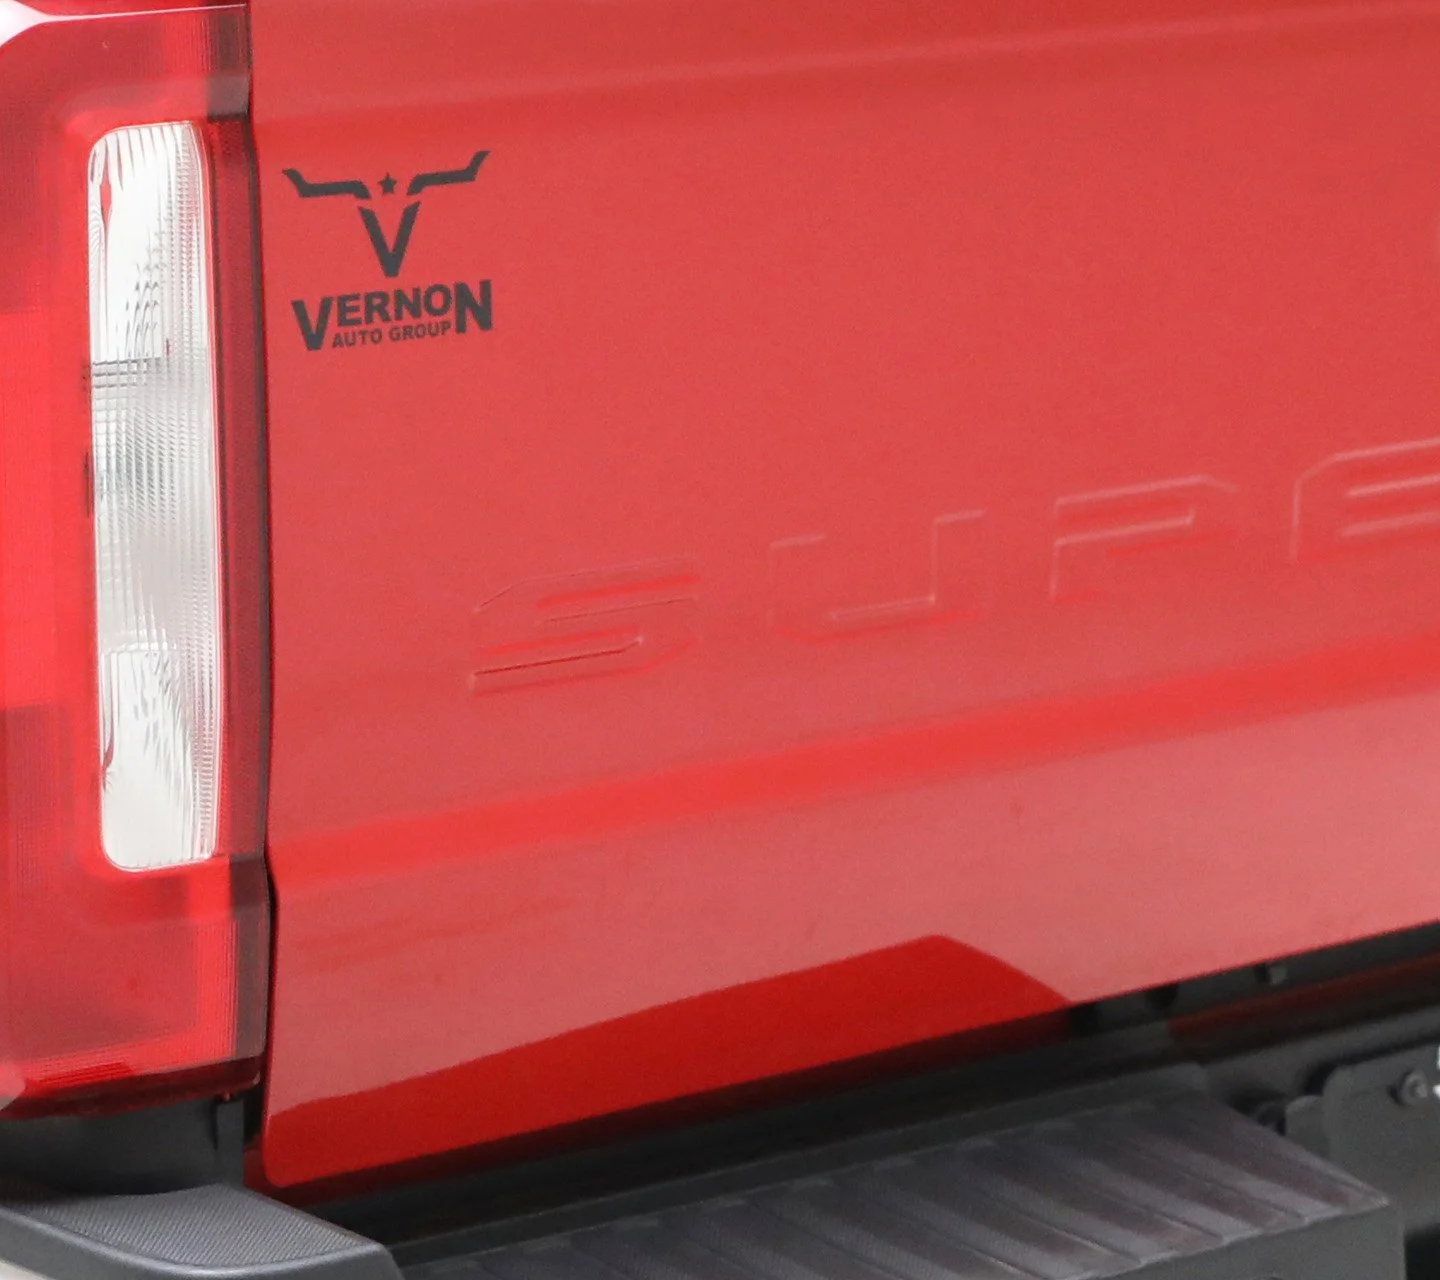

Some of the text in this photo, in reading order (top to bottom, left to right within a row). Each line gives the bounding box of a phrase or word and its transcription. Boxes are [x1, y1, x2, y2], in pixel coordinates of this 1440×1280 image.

[291, 279, 493, 352] VERNON
[331, 320, 452, 350] AUTO GROUP
